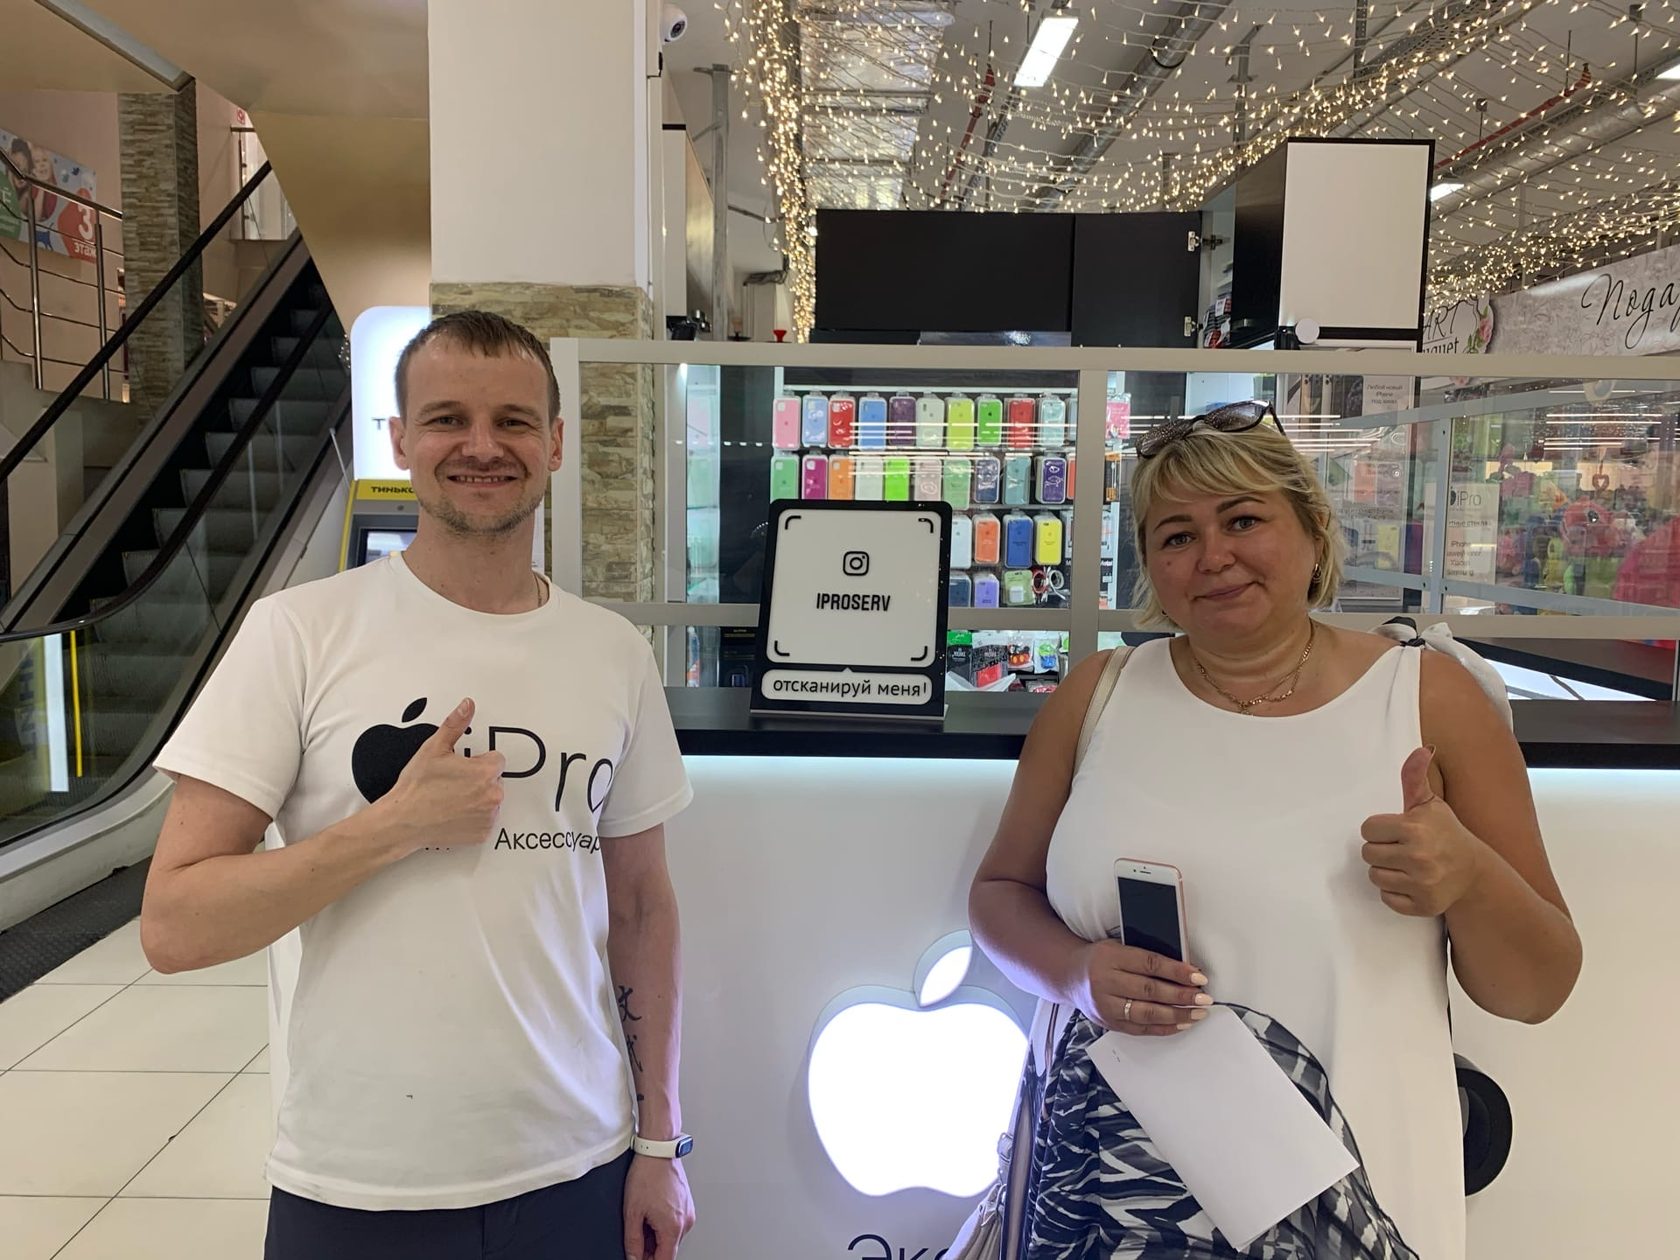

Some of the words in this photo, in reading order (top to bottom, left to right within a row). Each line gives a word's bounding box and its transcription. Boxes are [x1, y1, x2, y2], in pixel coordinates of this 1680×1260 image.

[1456, 490, 1482, 506] iPro
[816, 593, 891, 612] IPROSERV
[773, 679, 871, 698] отсканируй
